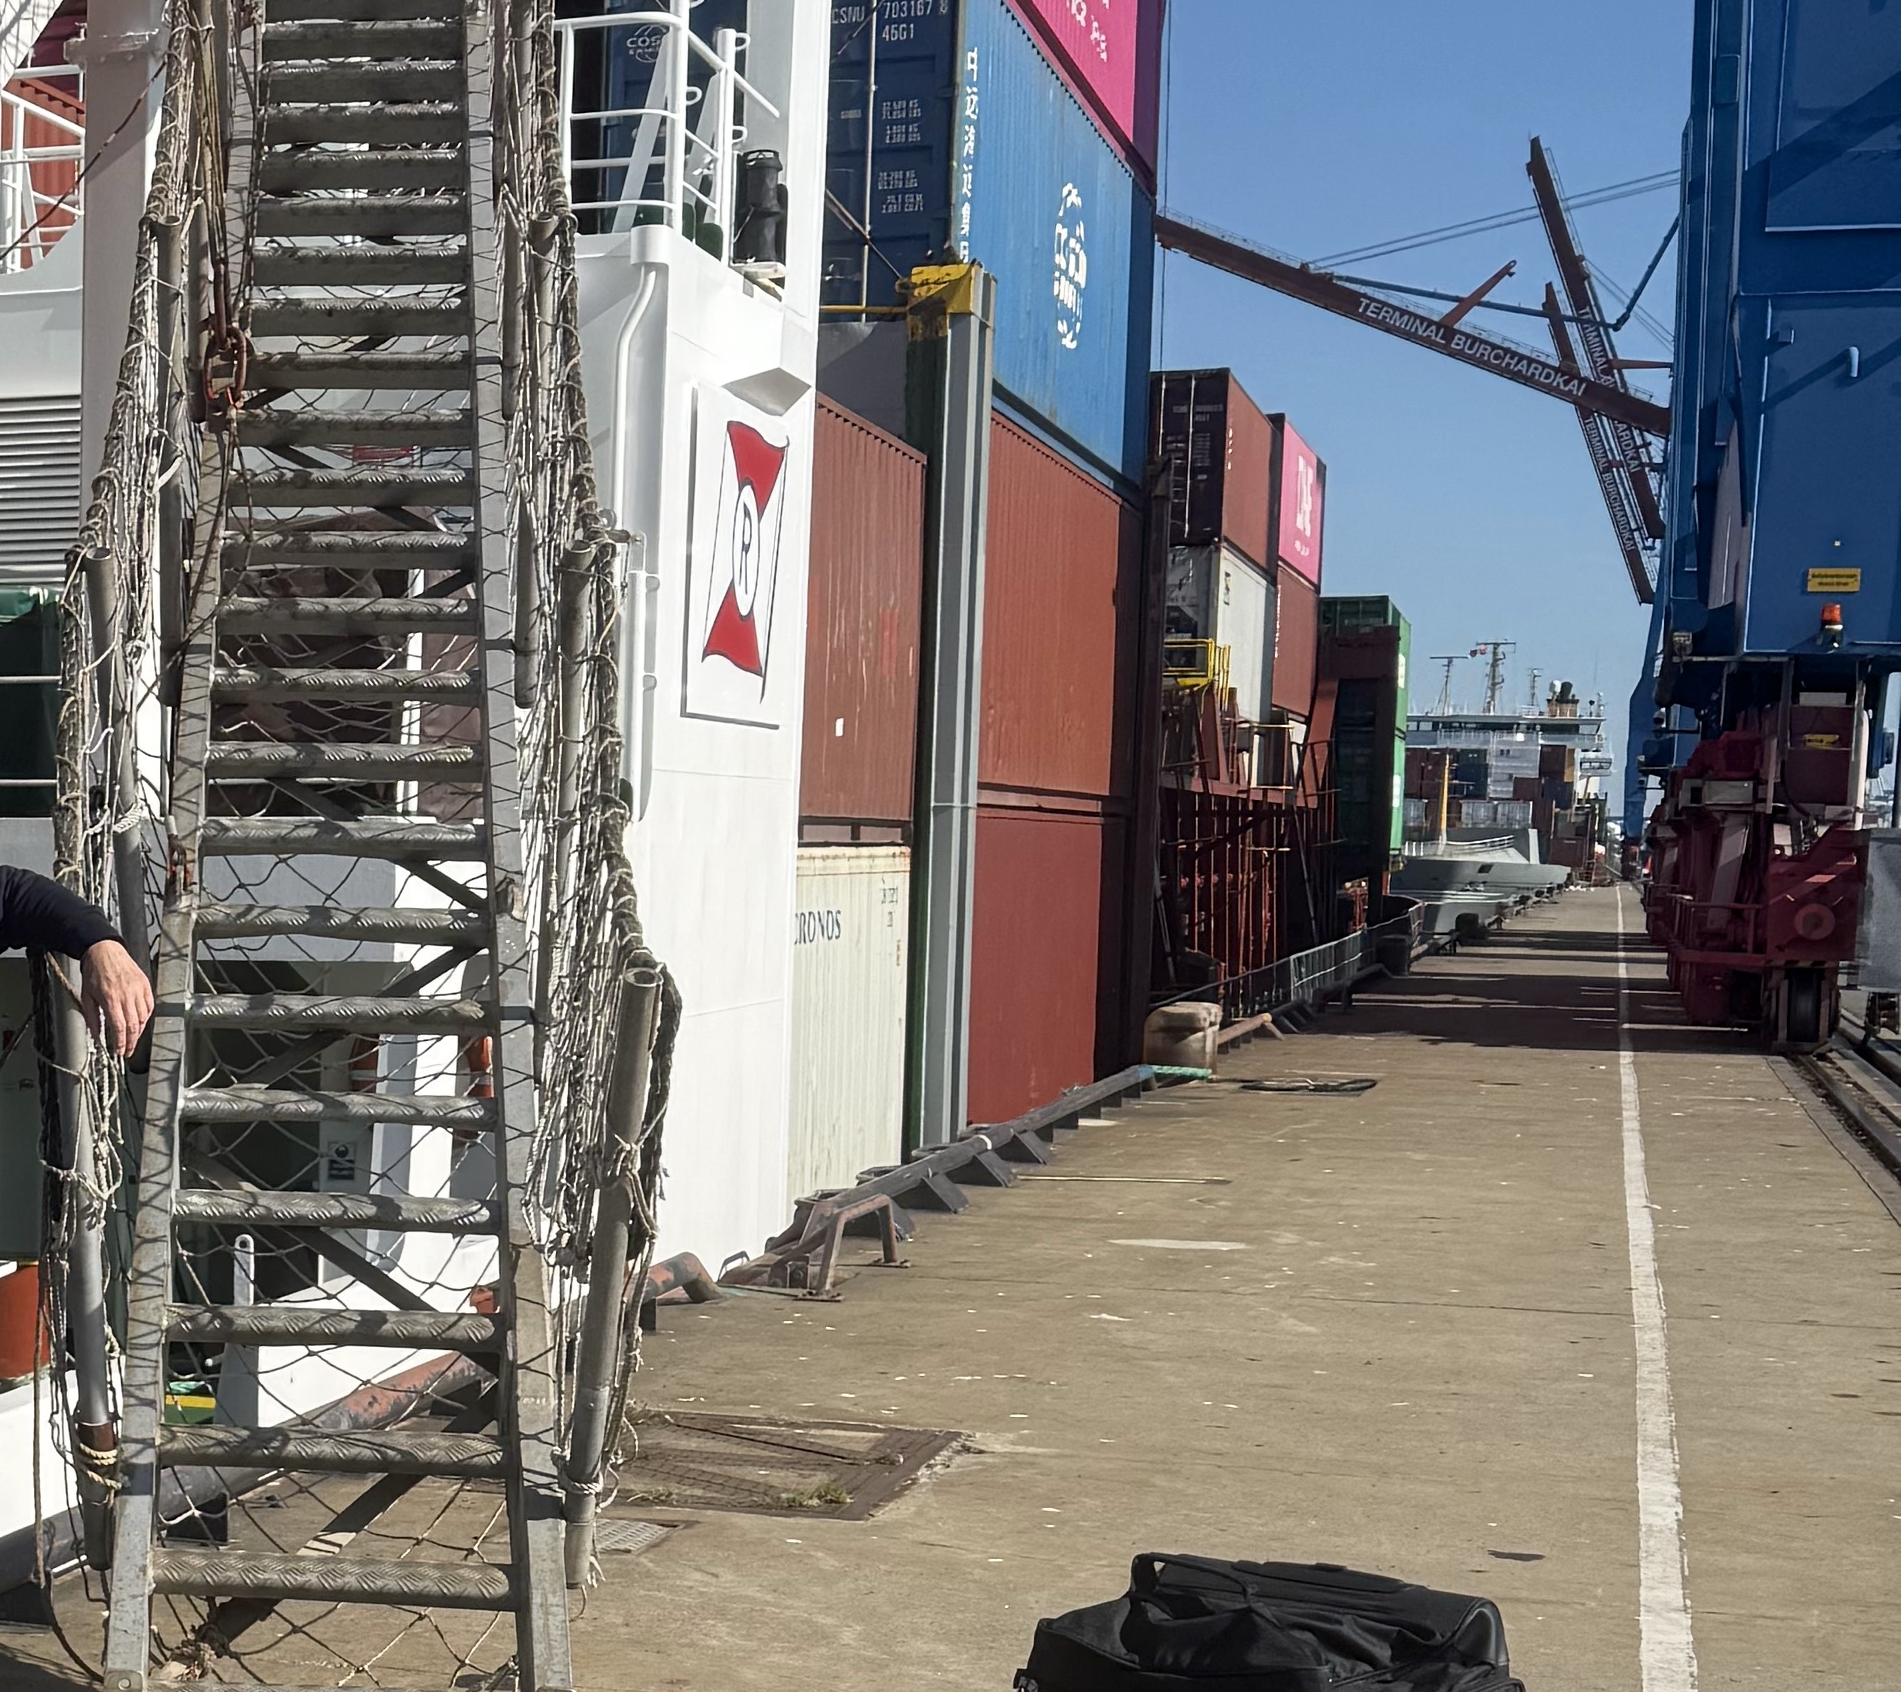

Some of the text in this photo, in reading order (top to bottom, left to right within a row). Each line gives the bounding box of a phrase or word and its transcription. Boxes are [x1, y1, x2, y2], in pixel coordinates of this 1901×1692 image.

[626, 34, 663, 48] COS
[1357, 298, 1587, 397] TERMINAL BURCHARDKAI
[1583, 417, 1635, 553] TERMINAL BURCHARDKAI
[738, 499, 753, 595] R
